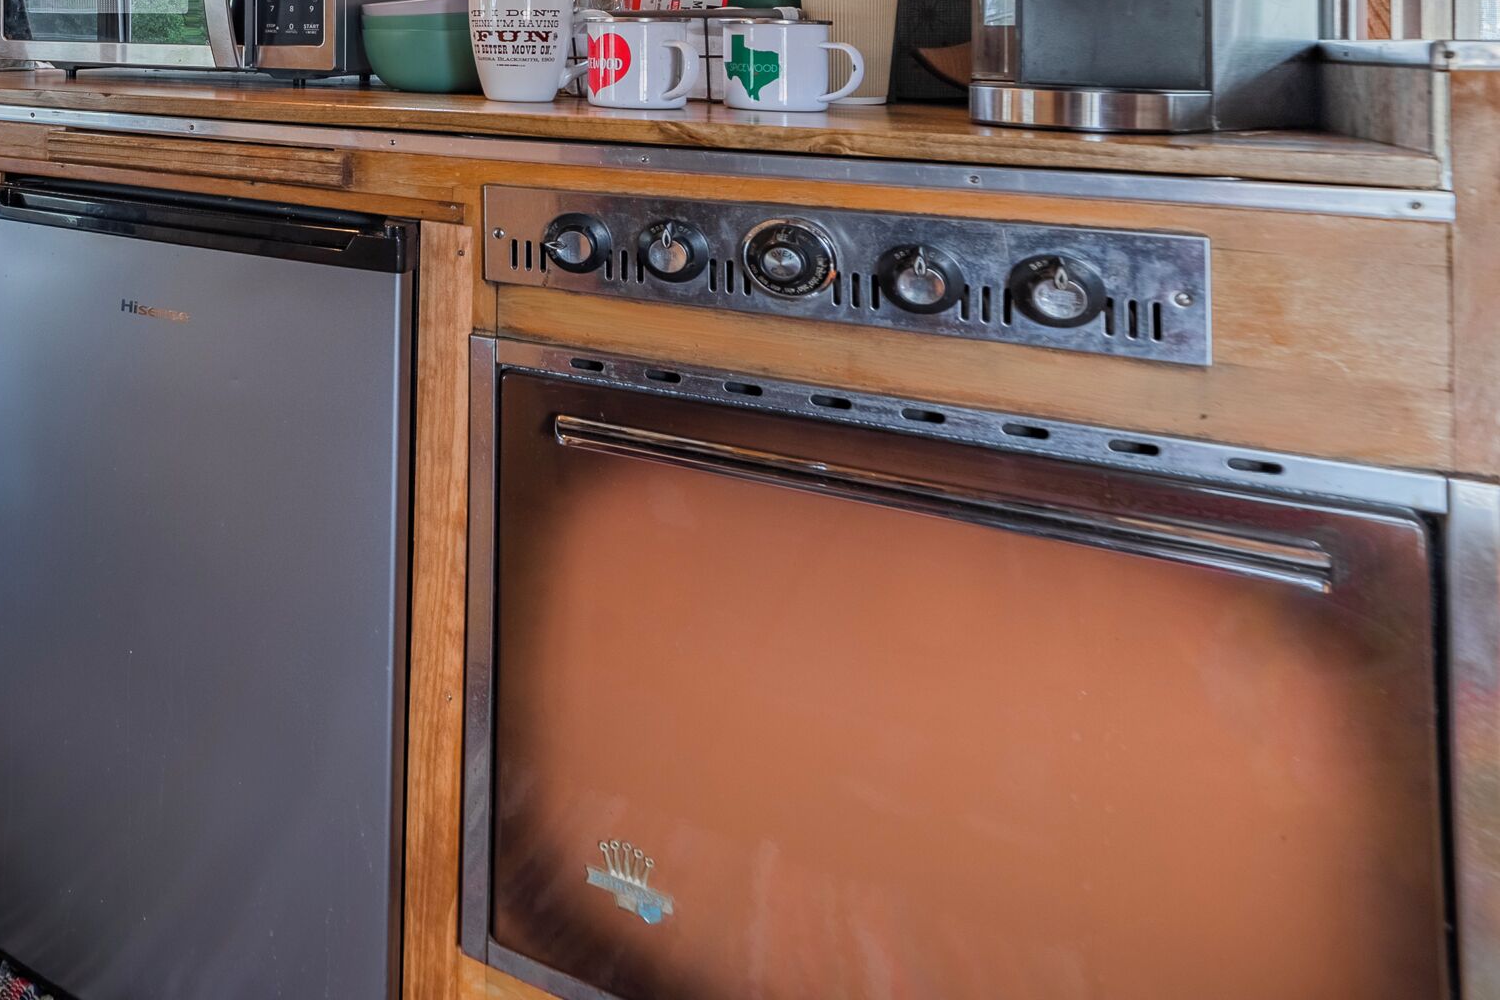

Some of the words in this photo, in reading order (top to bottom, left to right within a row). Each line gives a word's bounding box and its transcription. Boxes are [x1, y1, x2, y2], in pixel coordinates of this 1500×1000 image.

[496, 20, 514, 28] I'M
[518, 20, 559, 28] HAVING
[476, 31, 553, 42] FUN
[512, 45, 536, 55] MOVE
